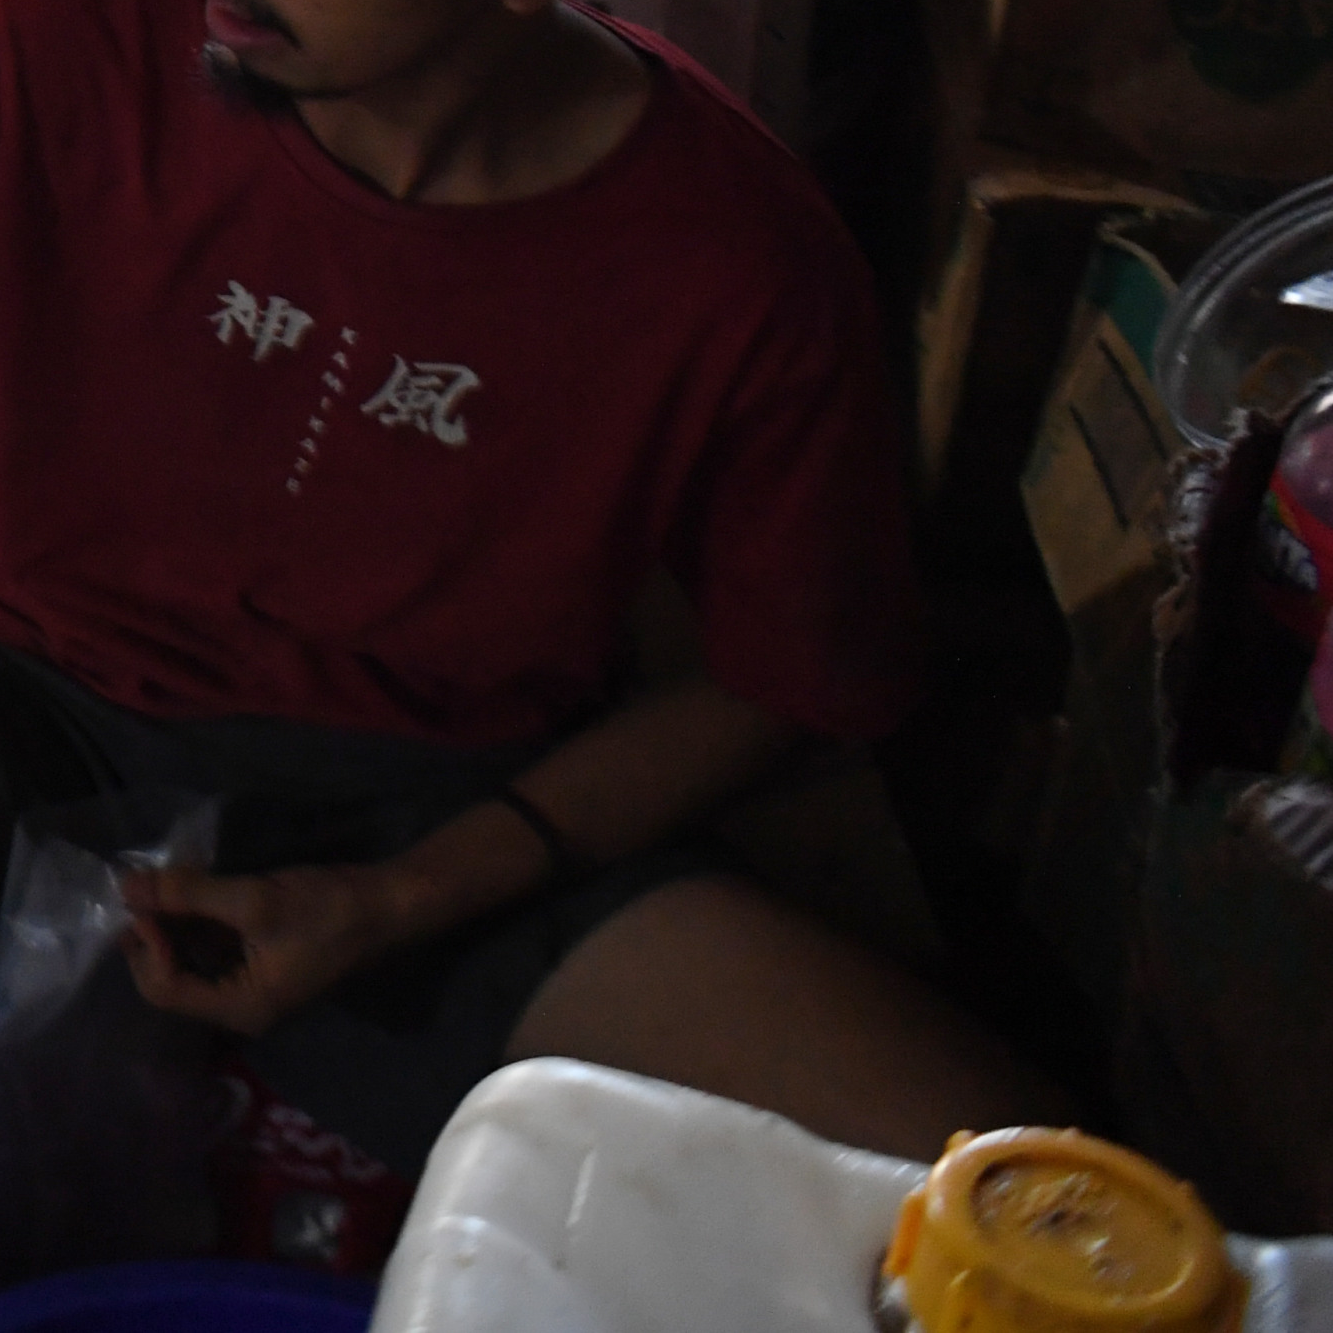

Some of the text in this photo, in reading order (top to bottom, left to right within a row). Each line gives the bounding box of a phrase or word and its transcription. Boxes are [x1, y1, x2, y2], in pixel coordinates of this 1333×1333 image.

[206, 279, 481, 446] 神 風
[286, 325, 358, 495] KAMIKAZE
